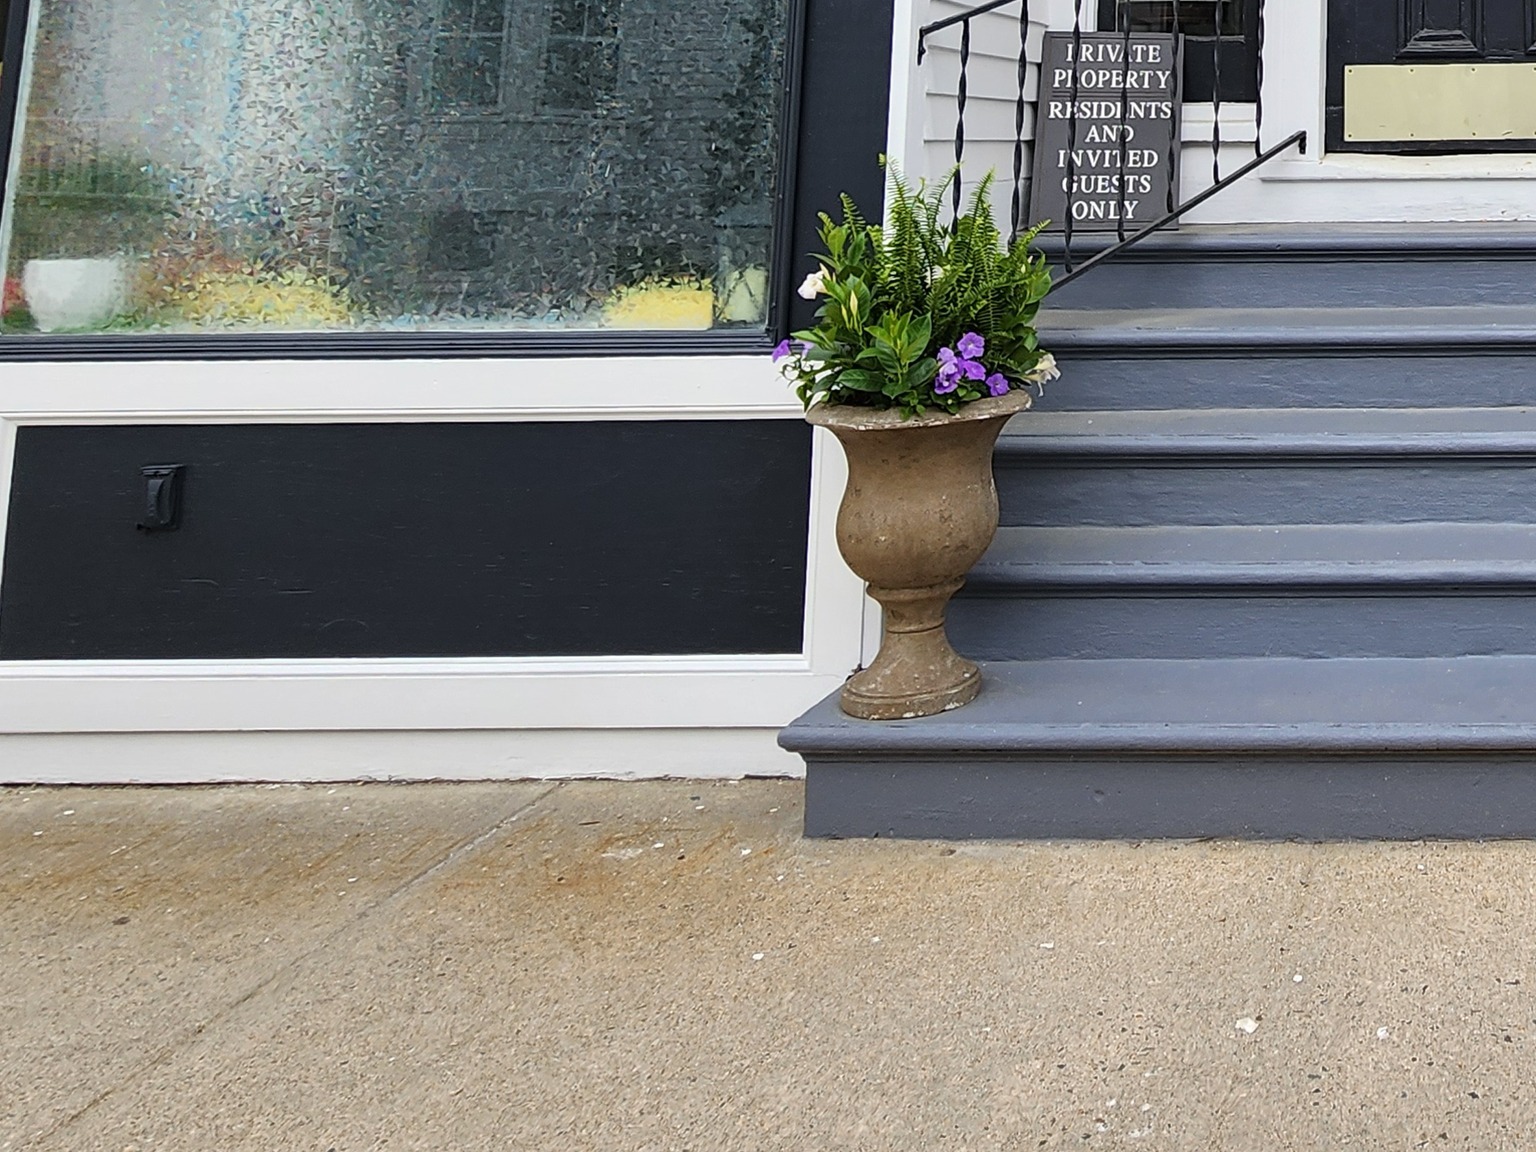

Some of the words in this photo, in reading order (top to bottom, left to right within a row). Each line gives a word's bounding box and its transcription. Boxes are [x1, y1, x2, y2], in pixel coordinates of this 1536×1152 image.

[1084, 124, 1134, 143] AND
[1057, 149, 1159, 168] INVITED
[1062, 174, 1152, 194] GUESTS
[1071, 200, 1139, 220] ONLY
